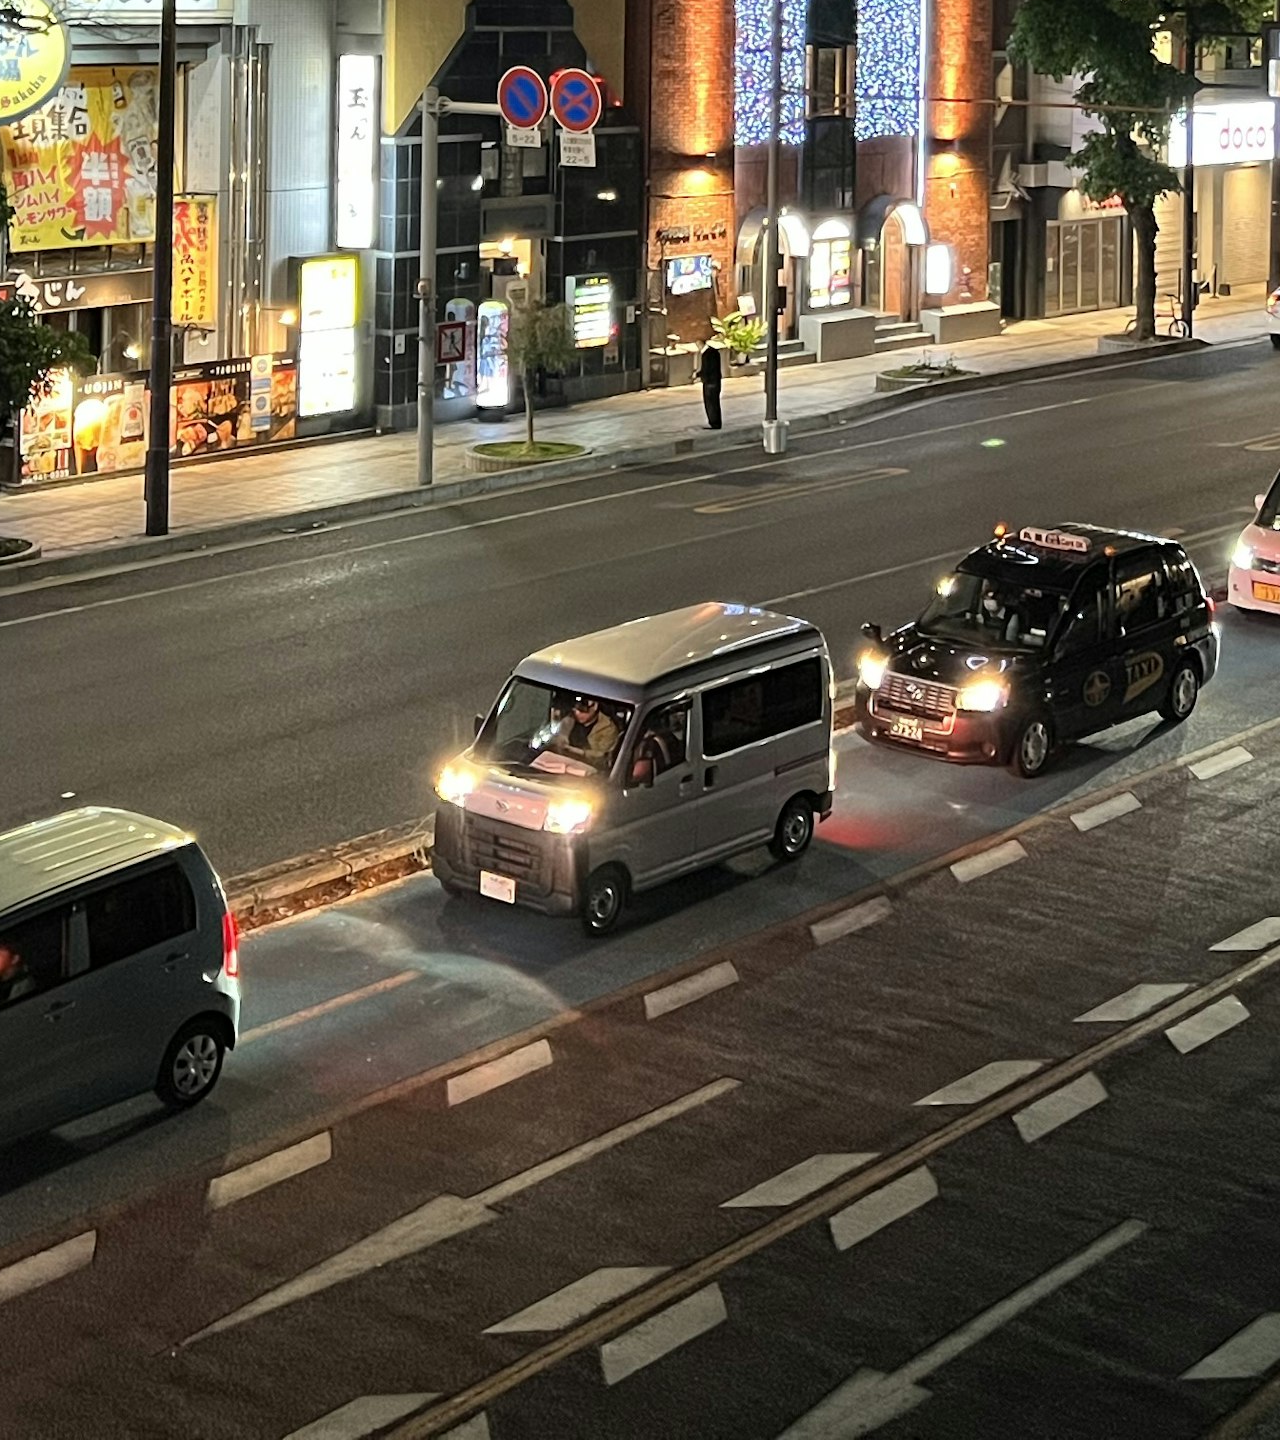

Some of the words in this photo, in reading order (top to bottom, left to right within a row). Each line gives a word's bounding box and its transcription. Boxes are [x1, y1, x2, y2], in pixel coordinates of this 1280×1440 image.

[80, 150, 113, 223] 半額
[16, 208, 73, 228] レモンサワー
